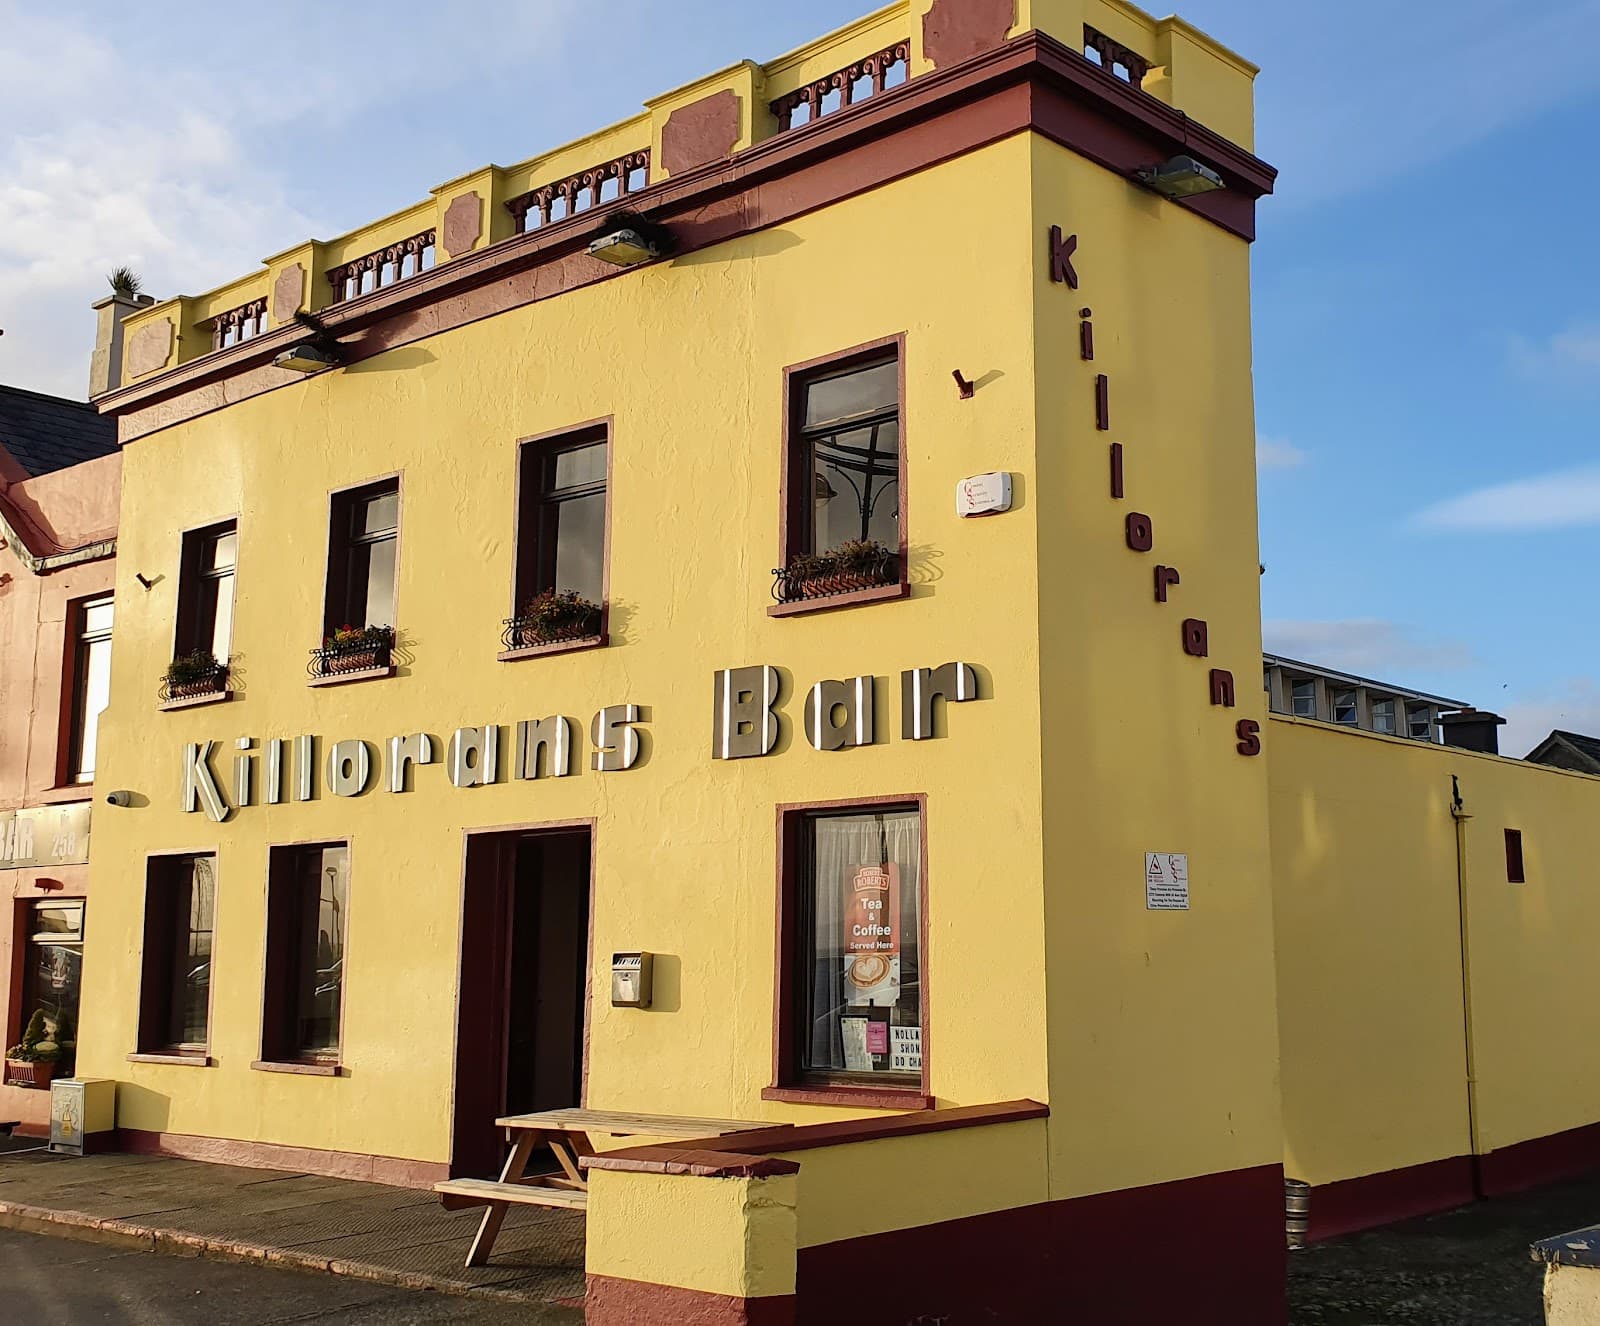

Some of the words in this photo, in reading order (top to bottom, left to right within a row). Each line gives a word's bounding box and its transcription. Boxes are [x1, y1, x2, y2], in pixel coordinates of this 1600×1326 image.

[1049, 225, 1261, 757] Killorans
[182, 704, 639, 822] Killorans
[712, 661, 977, 760] Bar
[856, 875, 886, 888] ROBERTS
[861, 898, 883, 910] Tea
[868, 912, 875, 921] &
[852, 924, 892, 937] Coffee
[850, 941, 875, 950] Served
[876, 941, 894, 949] Here
